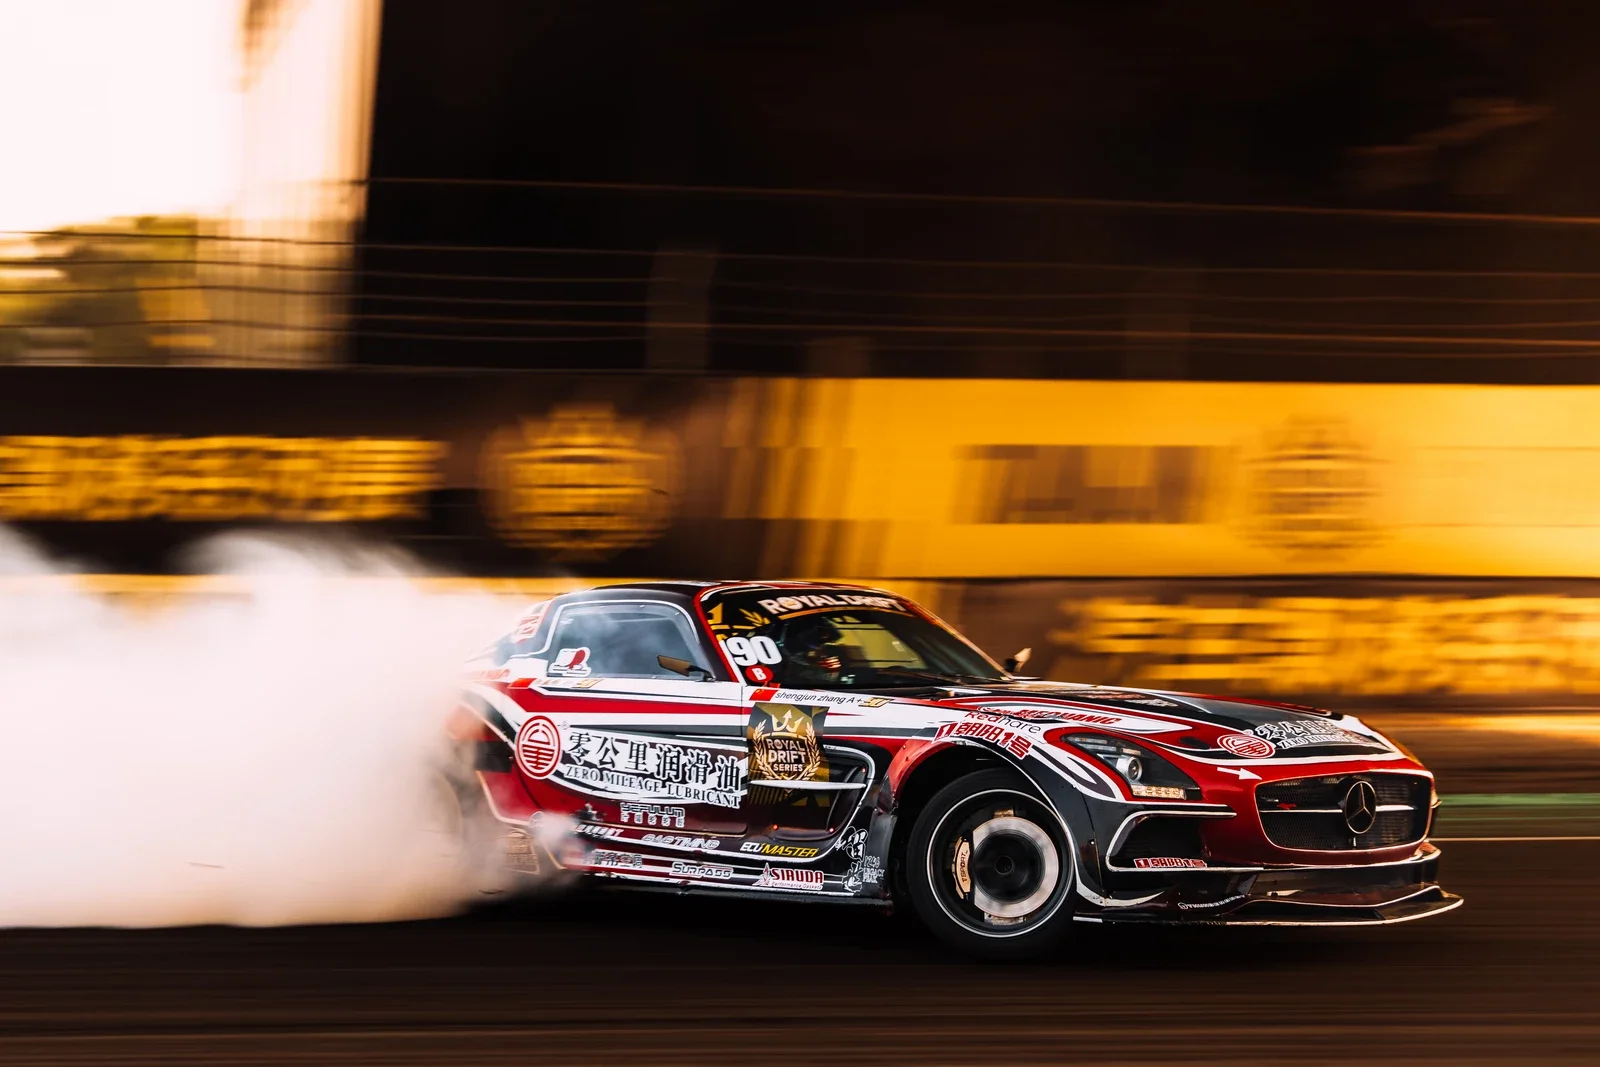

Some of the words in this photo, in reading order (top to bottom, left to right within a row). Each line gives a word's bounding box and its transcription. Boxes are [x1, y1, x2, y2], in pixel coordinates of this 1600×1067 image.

[726, 635, 783, 667] 90
[752, 667, 767, 681] B
[775, 691, 816, 702] shengjun
[817, 694, 847, 704] zhang
[965, 711, 1042, 734] Redhare
[766, 738, 806, 751] ROYAL
[568, 731, 741, 791] 零公里润滑油
[768, 750, 807, 763] DRIFT
[773, 763, 804, 772] SERIES
[566, 766, 600, 783] ZERO
[604, 770, 662, 793] MILEAGE
[666, 783, 741, 808] LUBRICANT
[771, 868, 824, 884] SIRUDA
